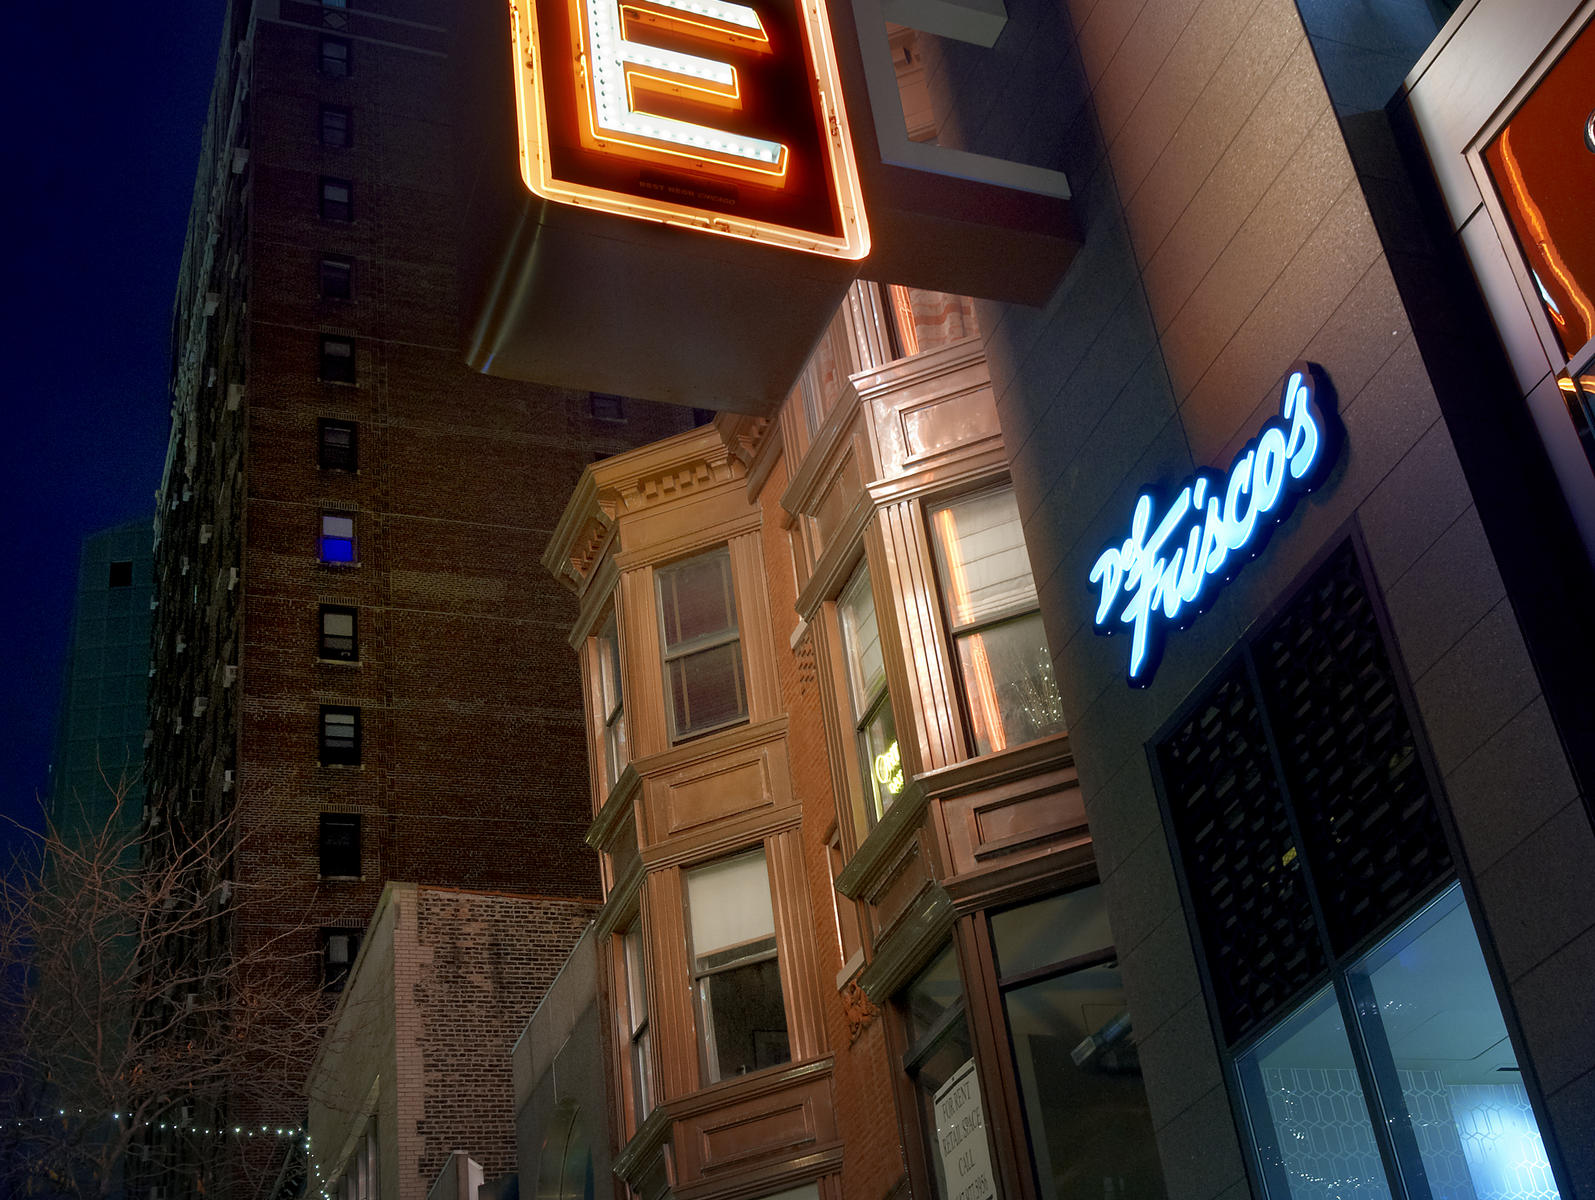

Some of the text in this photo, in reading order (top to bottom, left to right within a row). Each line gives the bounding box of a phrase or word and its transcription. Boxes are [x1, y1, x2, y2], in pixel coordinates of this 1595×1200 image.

[954, 1081, 970, 1110] RENT
[942, 1107, 982, 1157] RETAIL SPACE
[958, 1148, 976, 1177] CALL
